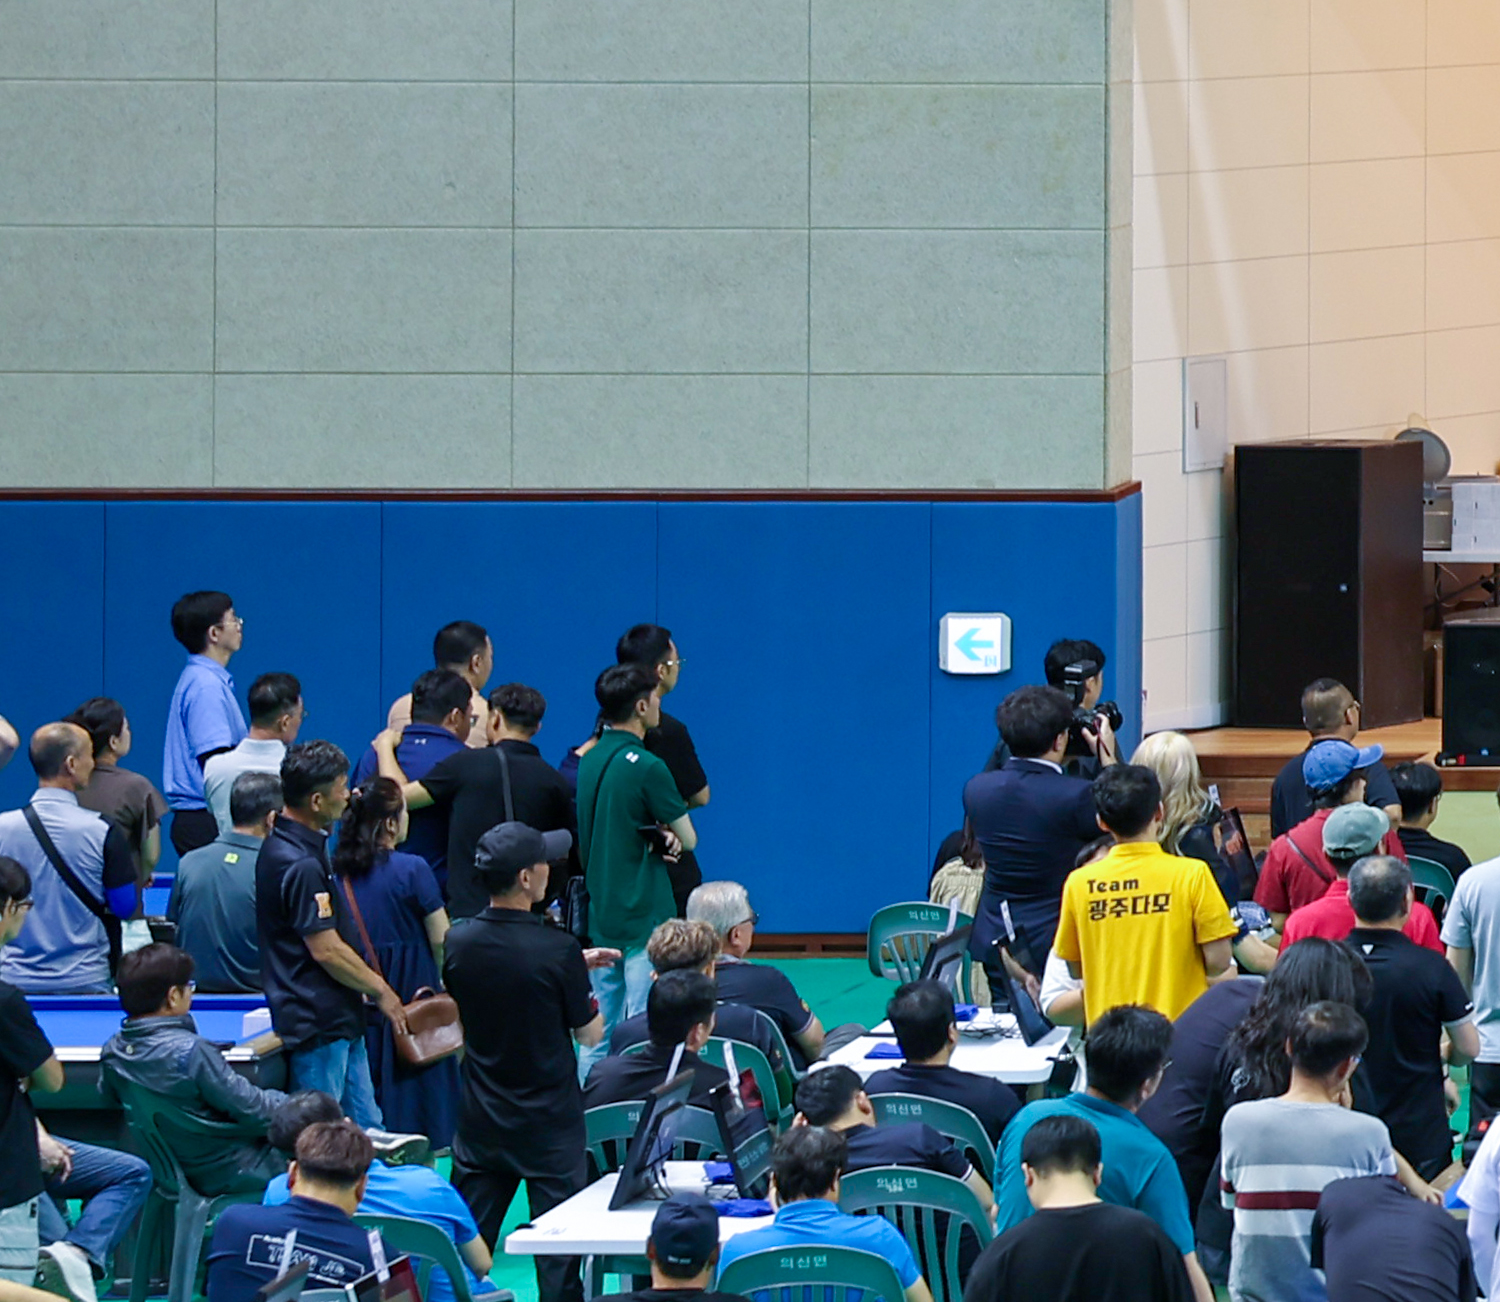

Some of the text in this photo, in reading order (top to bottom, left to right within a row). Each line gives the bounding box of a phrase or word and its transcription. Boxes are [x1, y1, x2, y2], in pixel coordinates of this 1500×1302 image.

[1086, 878, 1139, 894] Team
[1088, 893, 1172, 923] 광주다모
[886, 1102, 923, 1116] 의신면
[779, 1254, 828, 1270] 의신면
